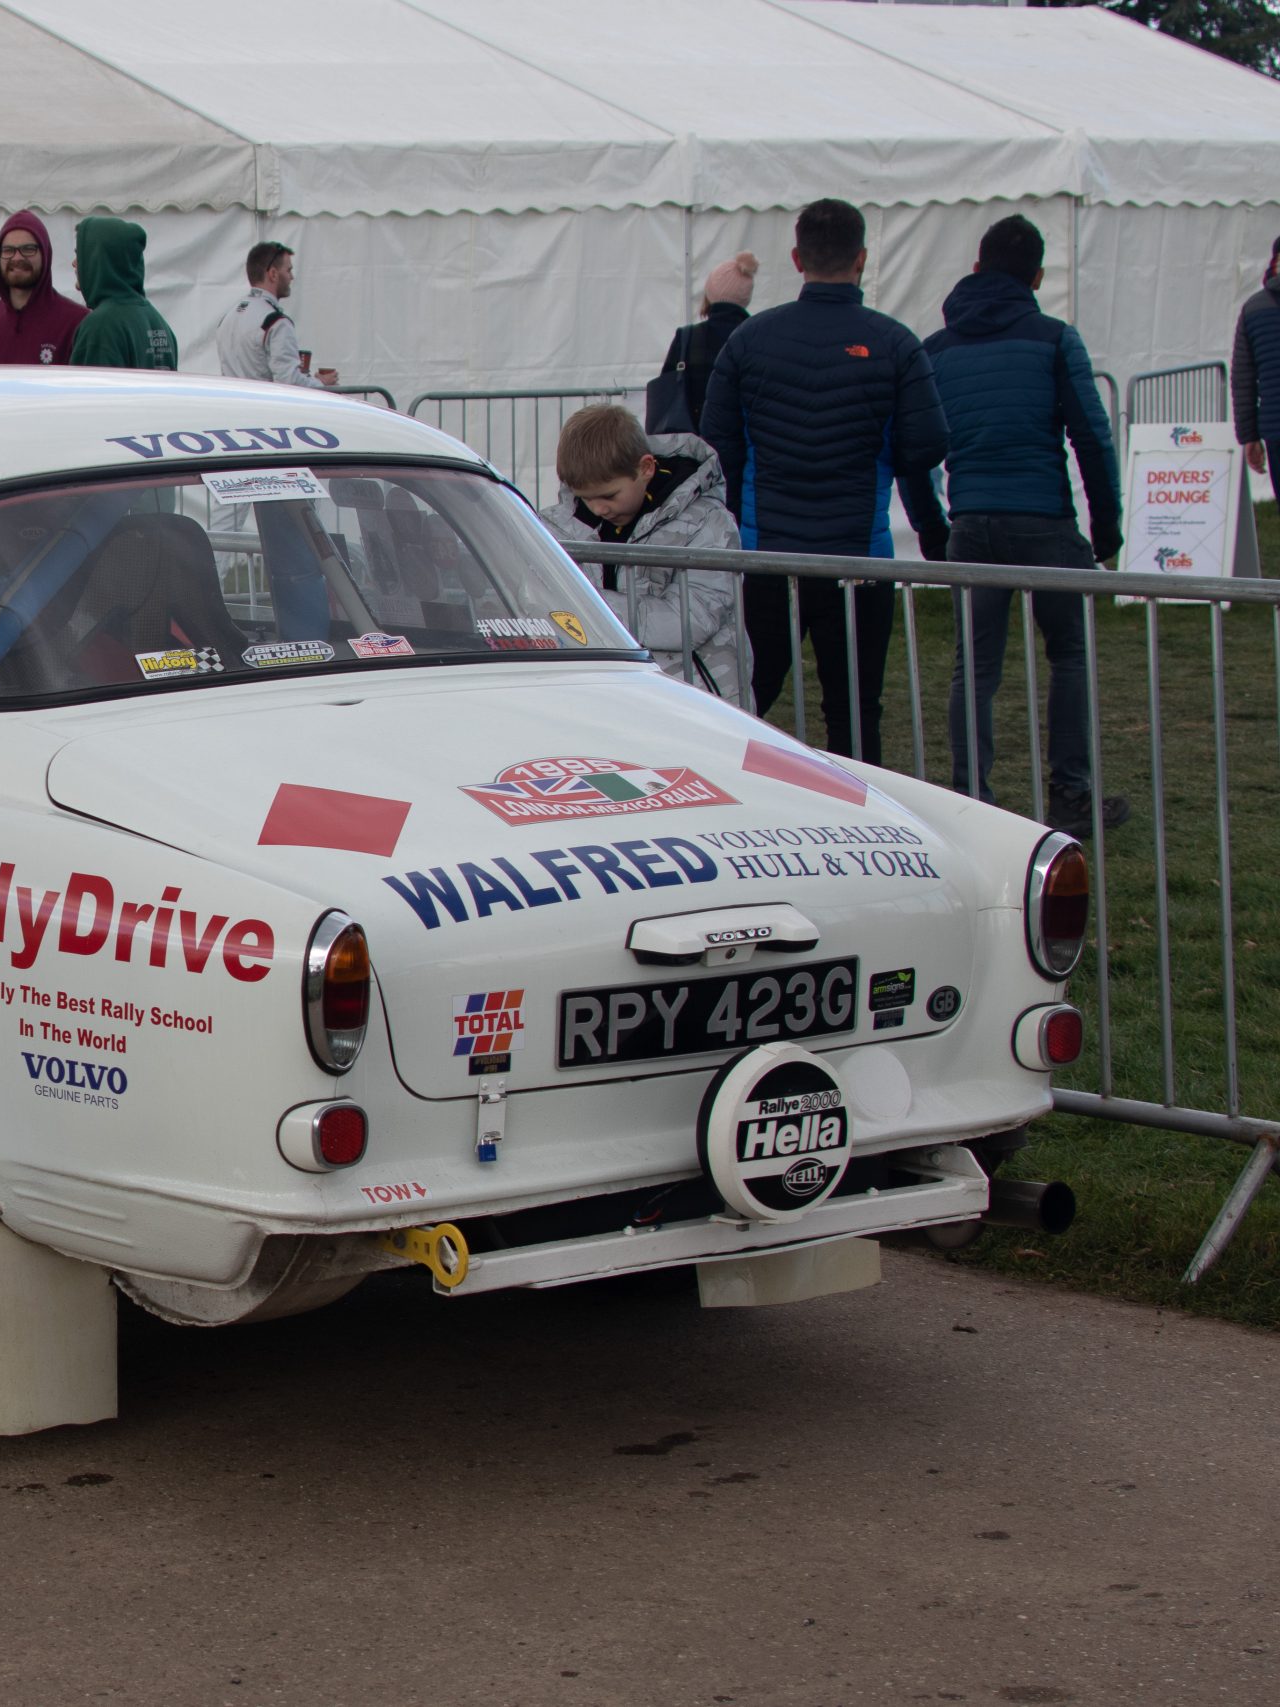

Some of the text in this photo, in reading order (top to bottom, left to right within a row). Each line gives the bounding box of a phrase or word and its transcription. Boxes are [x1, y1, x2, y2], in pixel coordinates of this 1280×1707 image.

[104, 426, 340, 459] VOLVO
[1147, 470, 1214, 484] DRIVERS'
[1147, 490, 1210, 504] LOUNGE
[254, 642, 320, 655] BACK TO
[140, 655, 198, 671] History
[514, 758, 621, 780] 1995
[489, 779, 718, 818] LONDON-MEXICO RALLY
[381, 825, 922, 931] WALFRED VOLVO DEALERS
[724, 850, 941, 880] HULL & YORK
[710, 928, 770, 942] VOLVO
[20, 985, 51, 1007] The
[57, 991, 95, 1015] Best
[101, 998, 145, 1027] Rally
[150, 1007, 213, 1034] School
[564, 966, 853, 1060] RPY 423G
[933, 990, 955, 1013] GB
[20, 1018, 126, 1053] In The World
[454, 1010, 524, 1036] TOTAL
[21, 1051, 128, 1095] VOLVO
[34, 1083, 119, 1110] GENUINE PARTS
[758, 1089, 841, 1115] Rallye 2000
[743, 1115, 841, 1159] Hella
[786, 1164, 827, 1183] HELLA
[361, 1183, 412, 1204] TOW
